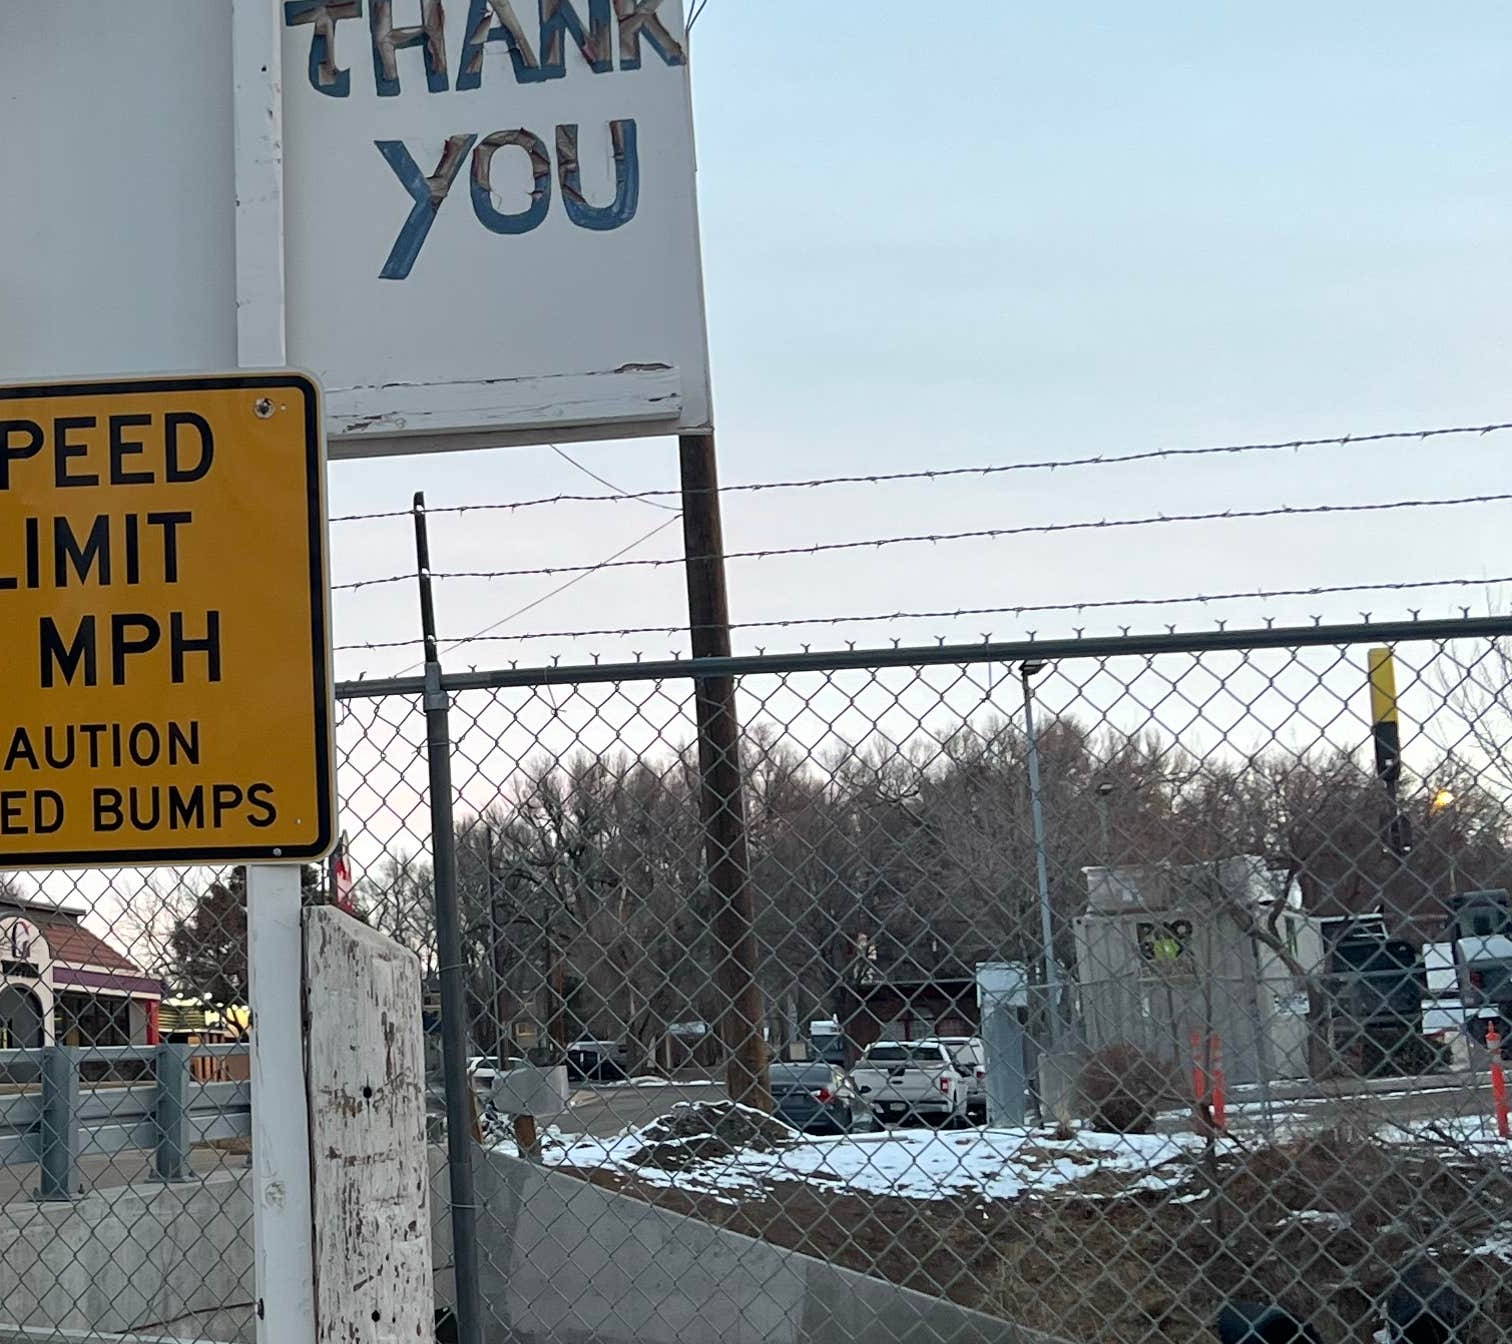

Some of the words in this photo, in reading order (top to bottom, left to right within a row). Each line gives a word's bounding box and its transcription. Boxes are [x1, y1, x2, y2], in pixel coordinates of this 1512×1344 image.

[373, 118, 639, 280] YOU
[39, 610, 221, 689] MPH
[92, 782, 278, 832] BUMPS
